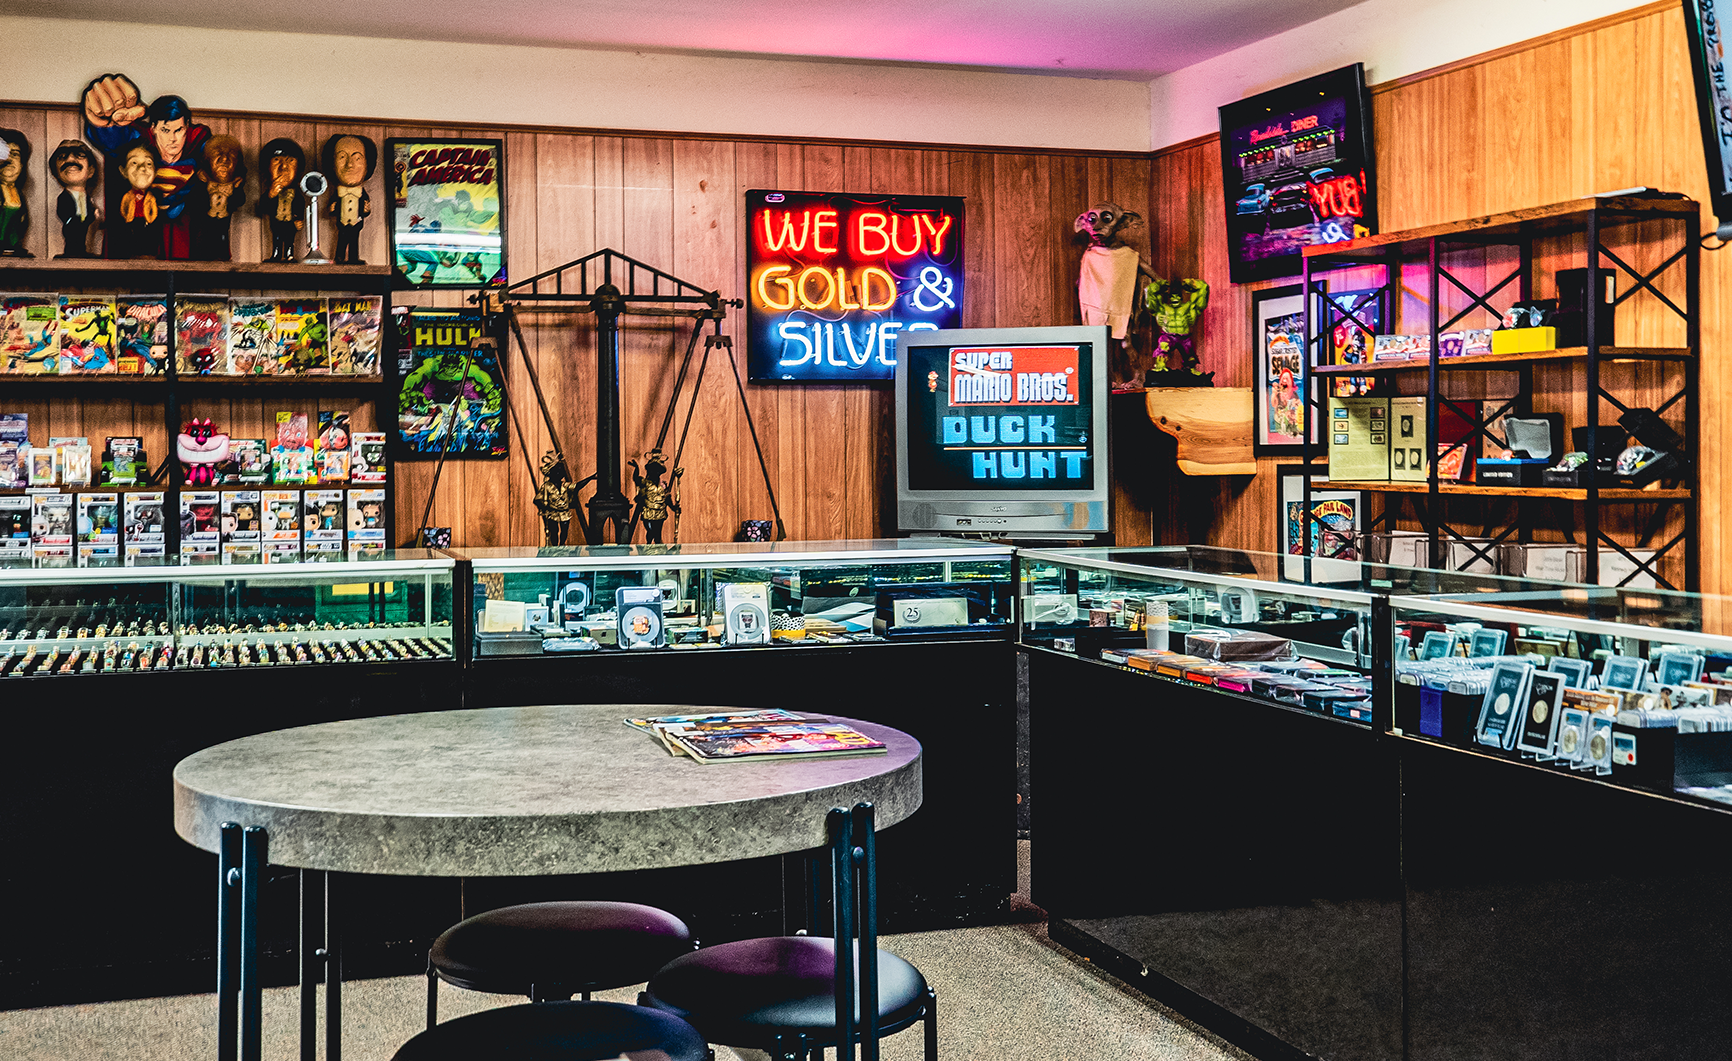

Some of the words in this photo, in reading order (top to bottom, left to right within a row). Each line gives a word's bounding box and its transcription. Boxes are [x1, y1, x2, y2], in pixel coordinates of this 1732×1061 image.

[1290, 115, 1319, 133] DINER
[409, 147, 491, 169] CAPTAIN
[407, 165, 495, 187] AMERICA
[763, 209, 838, 254] WE
[858, 211, 951, 256] BUY
[758, 265, 897, 311] GOLD
[913, 266, 955, 312] &
[65, 306, 111, 322] SUPERMAN
[126, 304, 167, 320] DRACULA
[415, 327, 481, 346] HULK
[778, 321, 939, 367] SILVE
[954, 351, 1013, 371] SUPER
[954, 373, 1013, 403] MARIO
[1016, 372, 1075, 403] BROS.
[942, 415, 1056, 444] DUCK
[972, 451, 1088, 479] HUNT
[906, 606, 920, 618] 25
